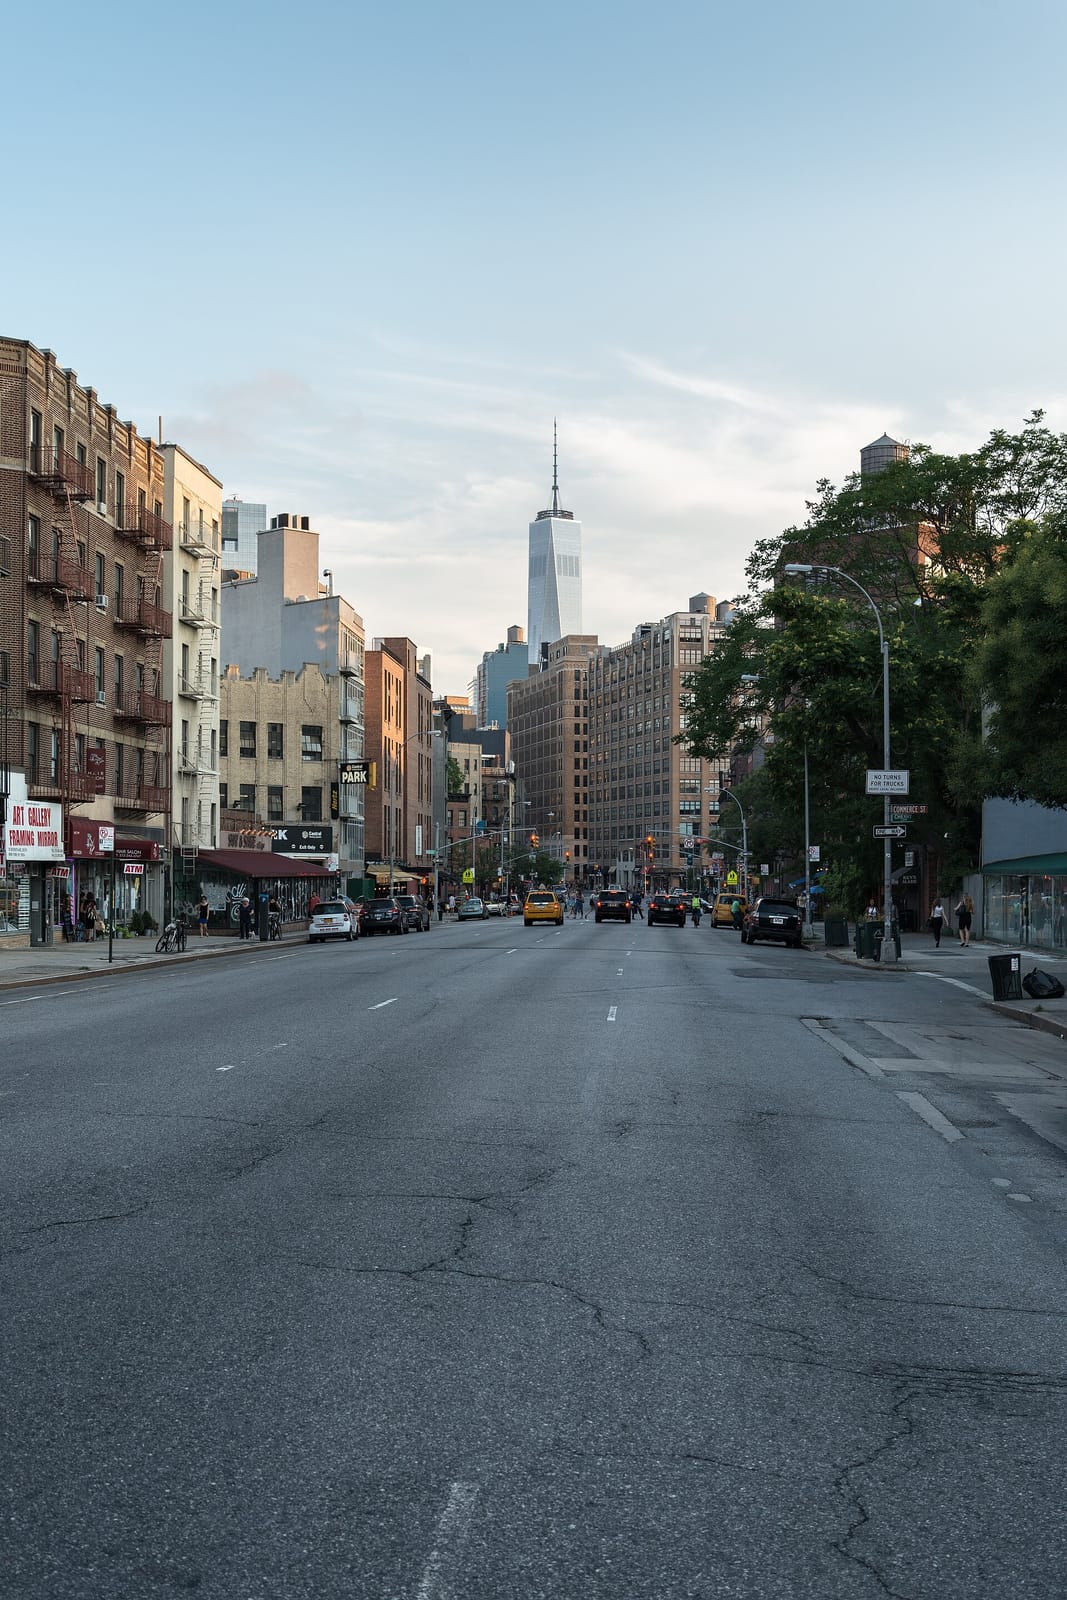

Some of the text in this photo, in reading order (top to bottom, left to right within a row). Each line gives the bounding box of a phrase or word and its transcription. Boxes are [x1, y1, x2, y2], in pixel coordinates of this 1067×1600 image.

[342, 770, 367, 783] PARK
[13, 806, 51, 827] ART GALLERY
[9, 830, 34, 846] FRAMING
[38, 832, 58, 846] MIRROR
[52, 868, 68, 877] ATM
